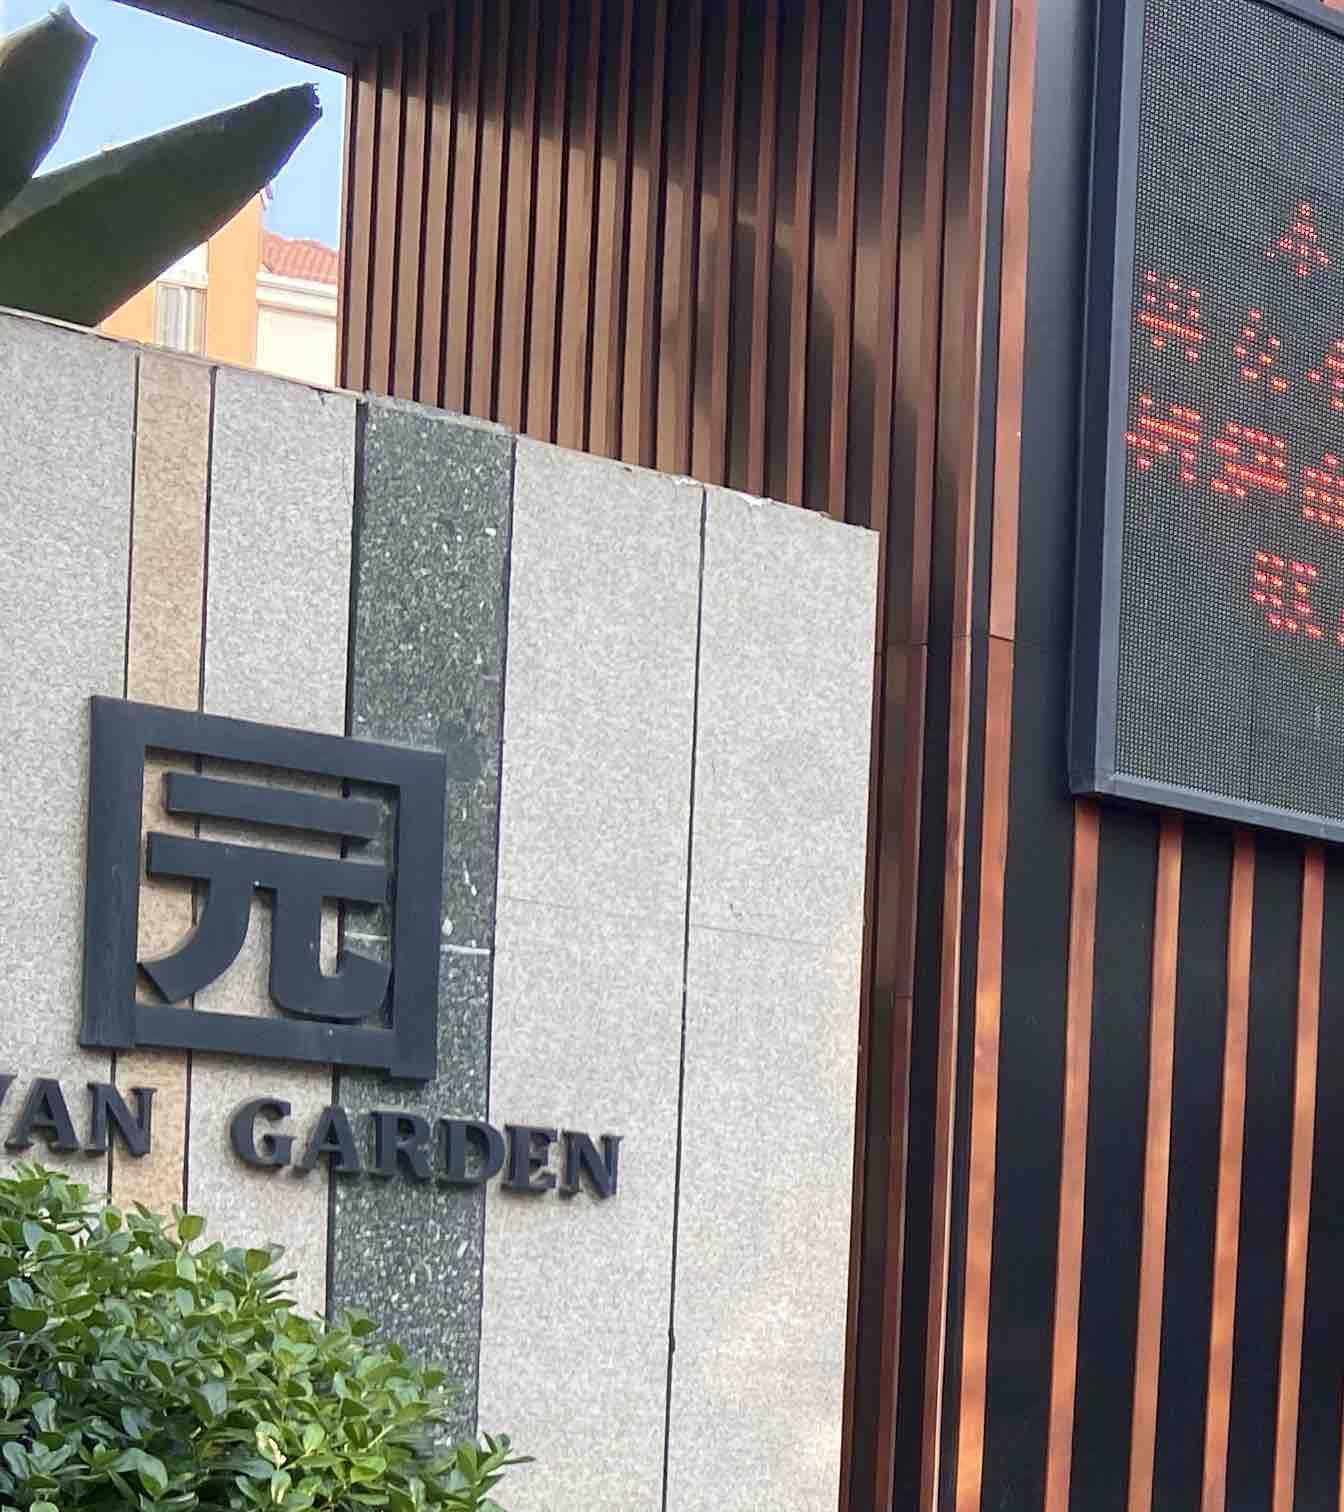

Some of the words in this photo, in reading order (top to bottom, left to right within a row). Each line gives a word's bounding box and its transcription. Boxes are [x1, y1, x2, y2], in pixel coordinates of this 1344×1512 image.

[82, 697, 445, 1079] 园
[0, 1074, 156, 1156] AN
[231, 1099, 623, 1197] GARDEN
